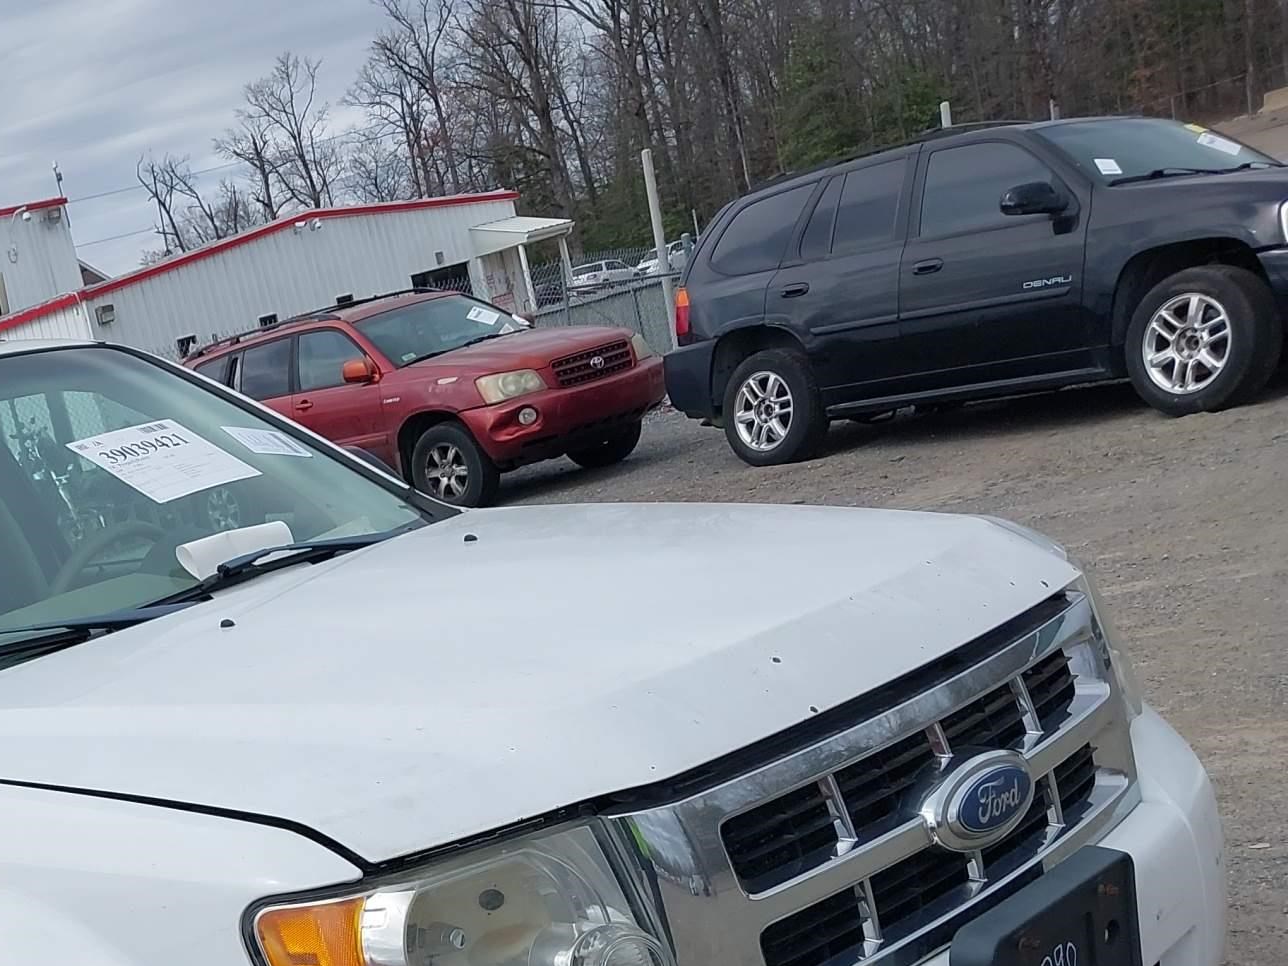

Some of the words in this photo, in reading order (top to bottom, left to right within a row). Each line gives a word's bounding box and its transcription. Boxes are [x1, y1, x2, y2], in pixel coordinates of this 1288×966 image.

[1022, 274, 1073, 289] DENALI
[99, 432, 190, 465] 39039421
[977, 775, 1022, 824] Ford
